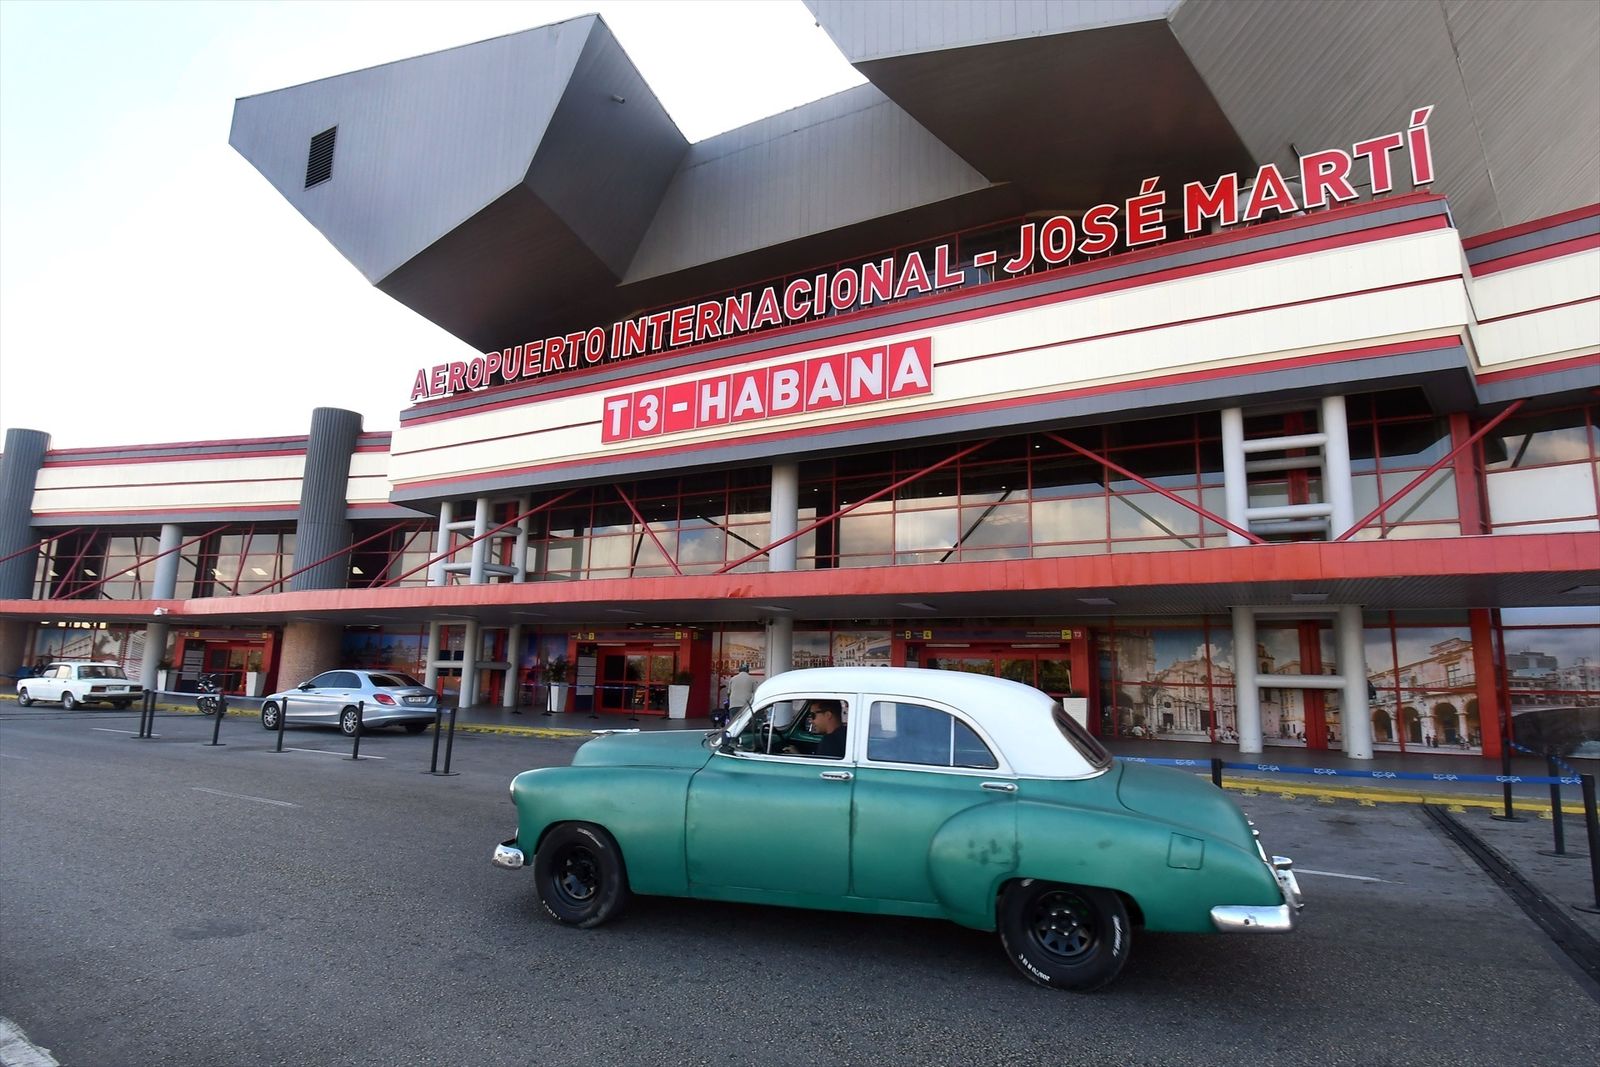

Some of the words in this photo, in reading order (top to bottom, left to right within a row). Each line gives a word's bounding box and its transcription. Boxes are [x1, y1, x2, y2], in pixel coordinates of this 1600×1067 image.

[410, 326, 605, 401] AEROPUERTO
[610, 244, 965, 359] INTERNACIONAL
[1003, 175, 1167, 275] JOSÉ
[1184, 104, 1436, 234] MARTÍ
